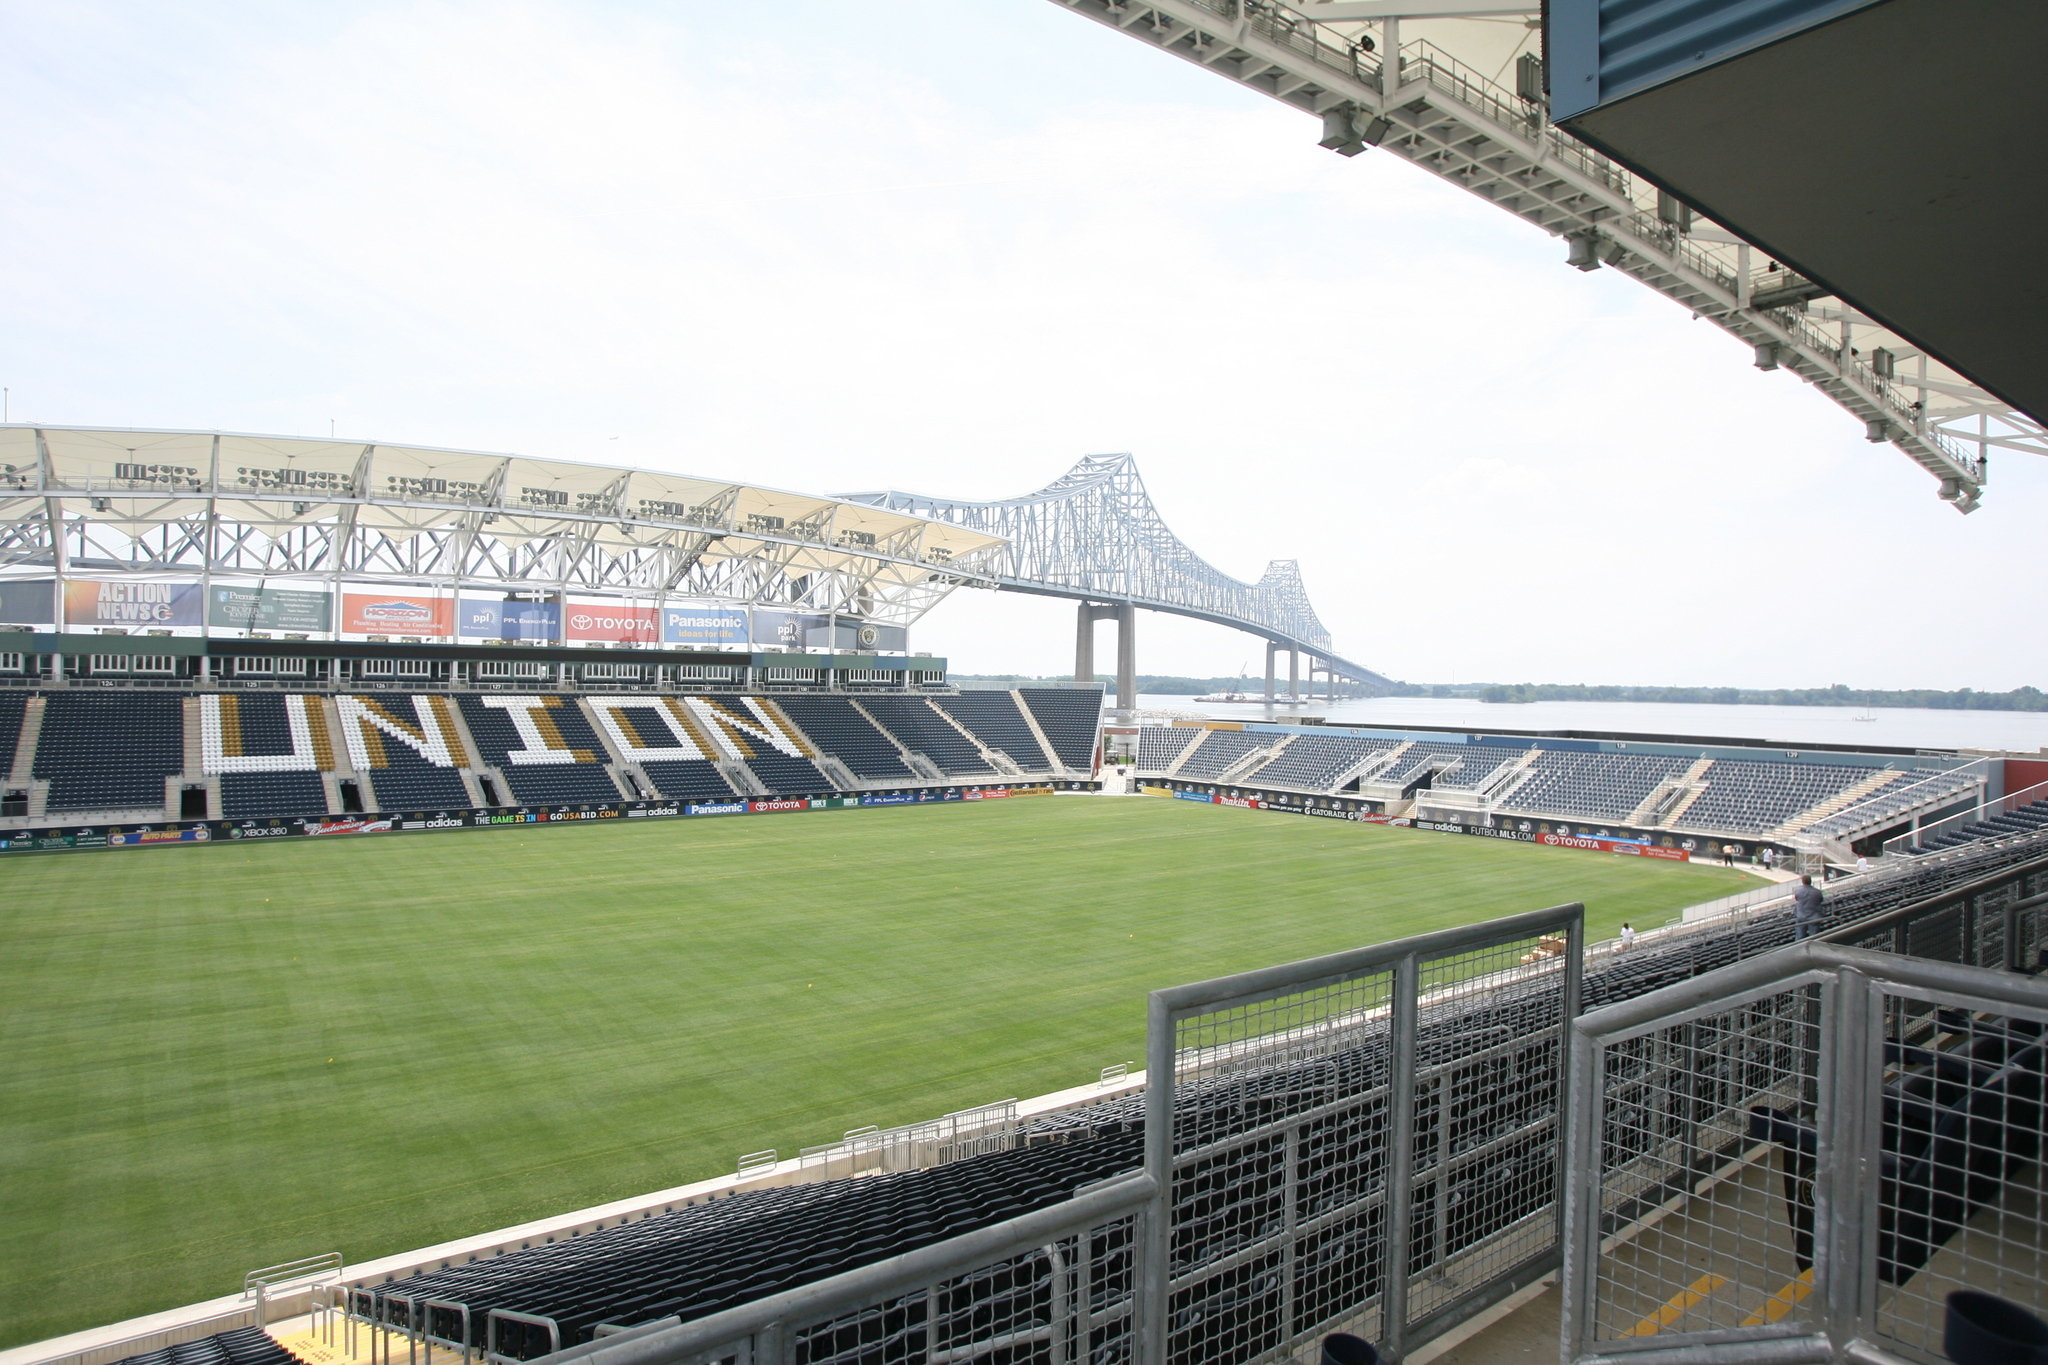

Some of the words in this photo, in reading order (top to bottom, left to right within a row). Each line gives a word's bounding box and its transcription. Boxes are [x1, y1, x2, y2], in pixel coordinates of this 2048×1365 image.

[97, 583, 171, 603] ACTION
[97, 602, 150, 621] NEWS
[365, 608, 429, 617] HORIZON
[473, 613, 490, 624] ppl
[594, 617, 654, 631] TOYOTA
[669, 613, 742, 628] Panasonic
[678, 629, 703, 638] ideas
[704, 629, 718, 638] for
[719, 630, 734, 638] life
[778, 623, 793, 636] ppl
[781, 634, 796, 642] park
[200, 694, 814, 774] UNION
[691, 803, 743, 814] Panasonic
[767, 801, 801, 810] TOYOTA
[550, 810, 619, 821] GOUSABID.COM
[648, 807, 678, 816] adidas
[1304, 807, 1311, 815] G
[1311, 808, 1347, 819] GATORADE
[1347, 812, 1354, 820] G
[426, 817, 463, 828] adidas
[475, 815, 490, 825] THE
[491, 814, 515, 824] GAME
[515, 814, 525, 823] IS
[526, 814, 536, 822] IN
[537, 813, 547, 822] US
[243, 829, 269, 837] XBOX
[270, 827, 288, 836] 360
[309, 821, 366, 836] Budweiser
[1434, 823, 1463, 833] adidas
[1470, 826, 1536, 842] FUTBOLMLS.COM
[1559, 836, 1600, 849] TOYOTA
